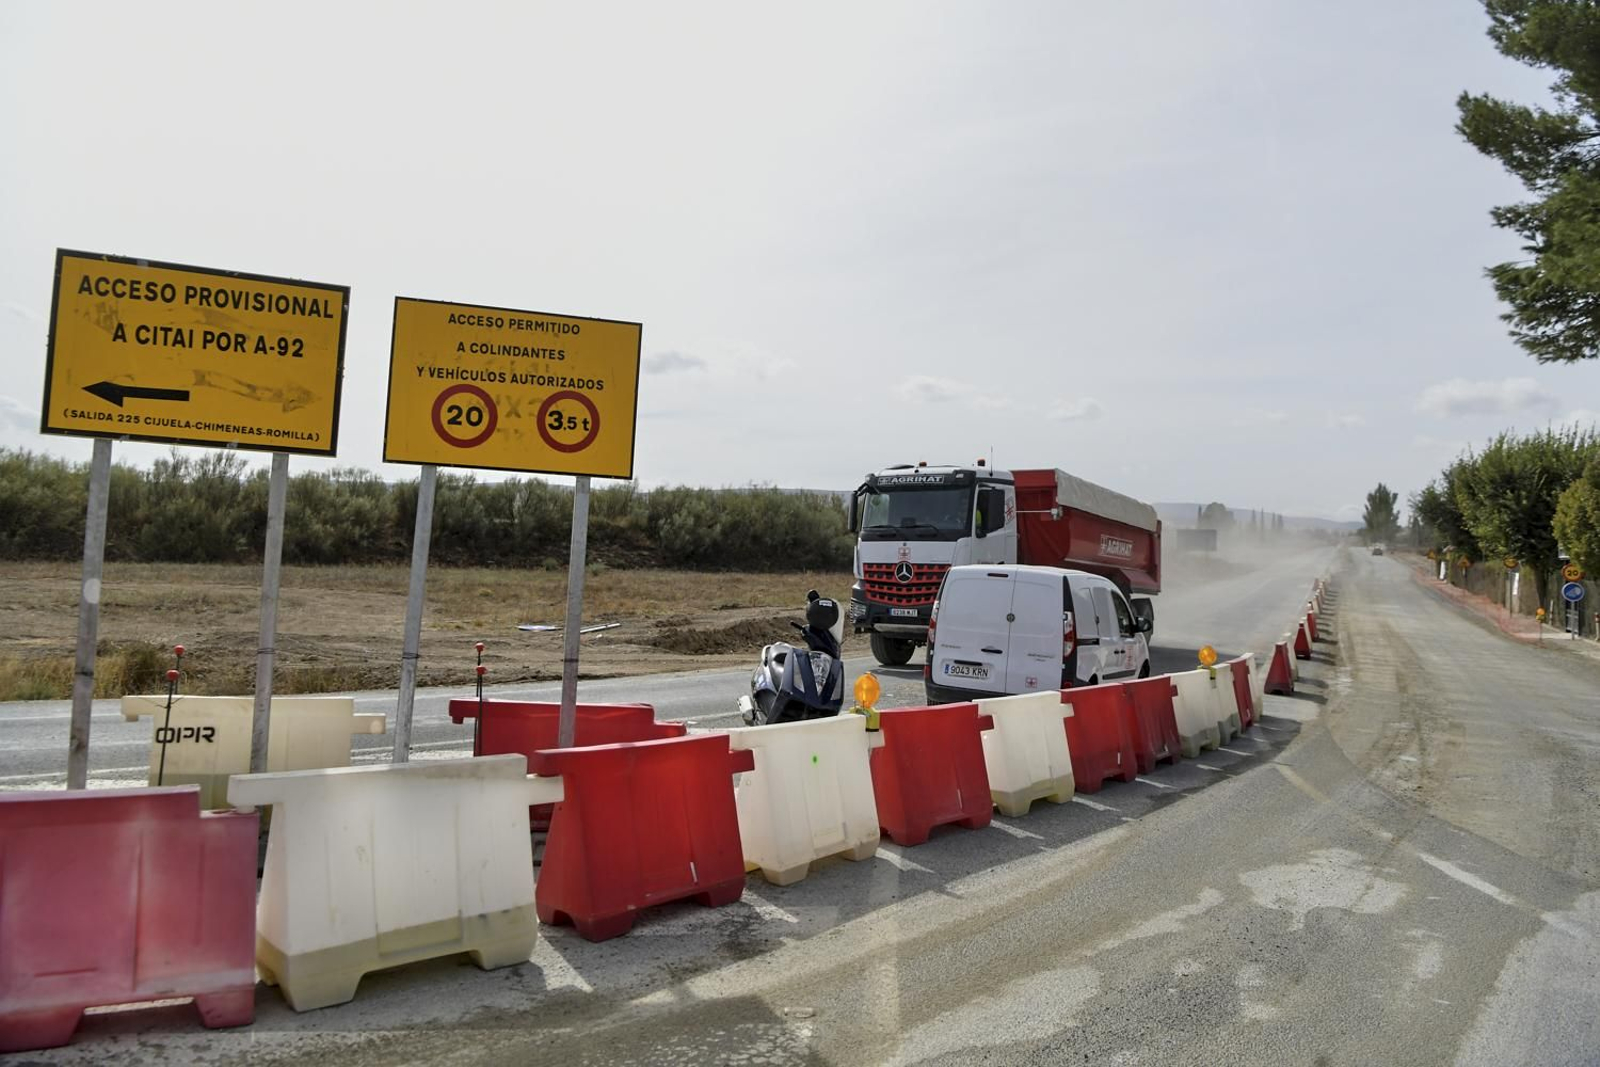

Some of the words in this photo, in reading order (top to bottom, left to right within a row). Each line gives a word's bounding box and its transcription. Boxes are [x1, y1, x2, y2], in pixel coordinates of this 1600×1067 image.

[78, 274, 176, 304] ACCESO
[184, 285, 334, 319] PROVISIONAL
[448, 313, 504, 329] ACCESO
[509, 318, 580, 335] PERMITIDO
[112, 324, 127, 343] A
[135, 325, 194, 349] CITAI
[202, 331, 246, 353] POR
[253, 335, 304, 358] A-92
[456, 341, 467, 353] A
[470, 342, 565, 360] COLINDANTES
[416, 366, 424, 377] Y
[428, 366, 506, 383] VEHÍCULOS
[510, 373, 604, 391] AUTORIZADOS
[117, 414, 141, 424] 225
[446, 405, 483, 427] 20
[1566, 569, 1579, 577] 20
[949, 665, 970, 675] 9043
[971, 667, 988, 677] KRN
